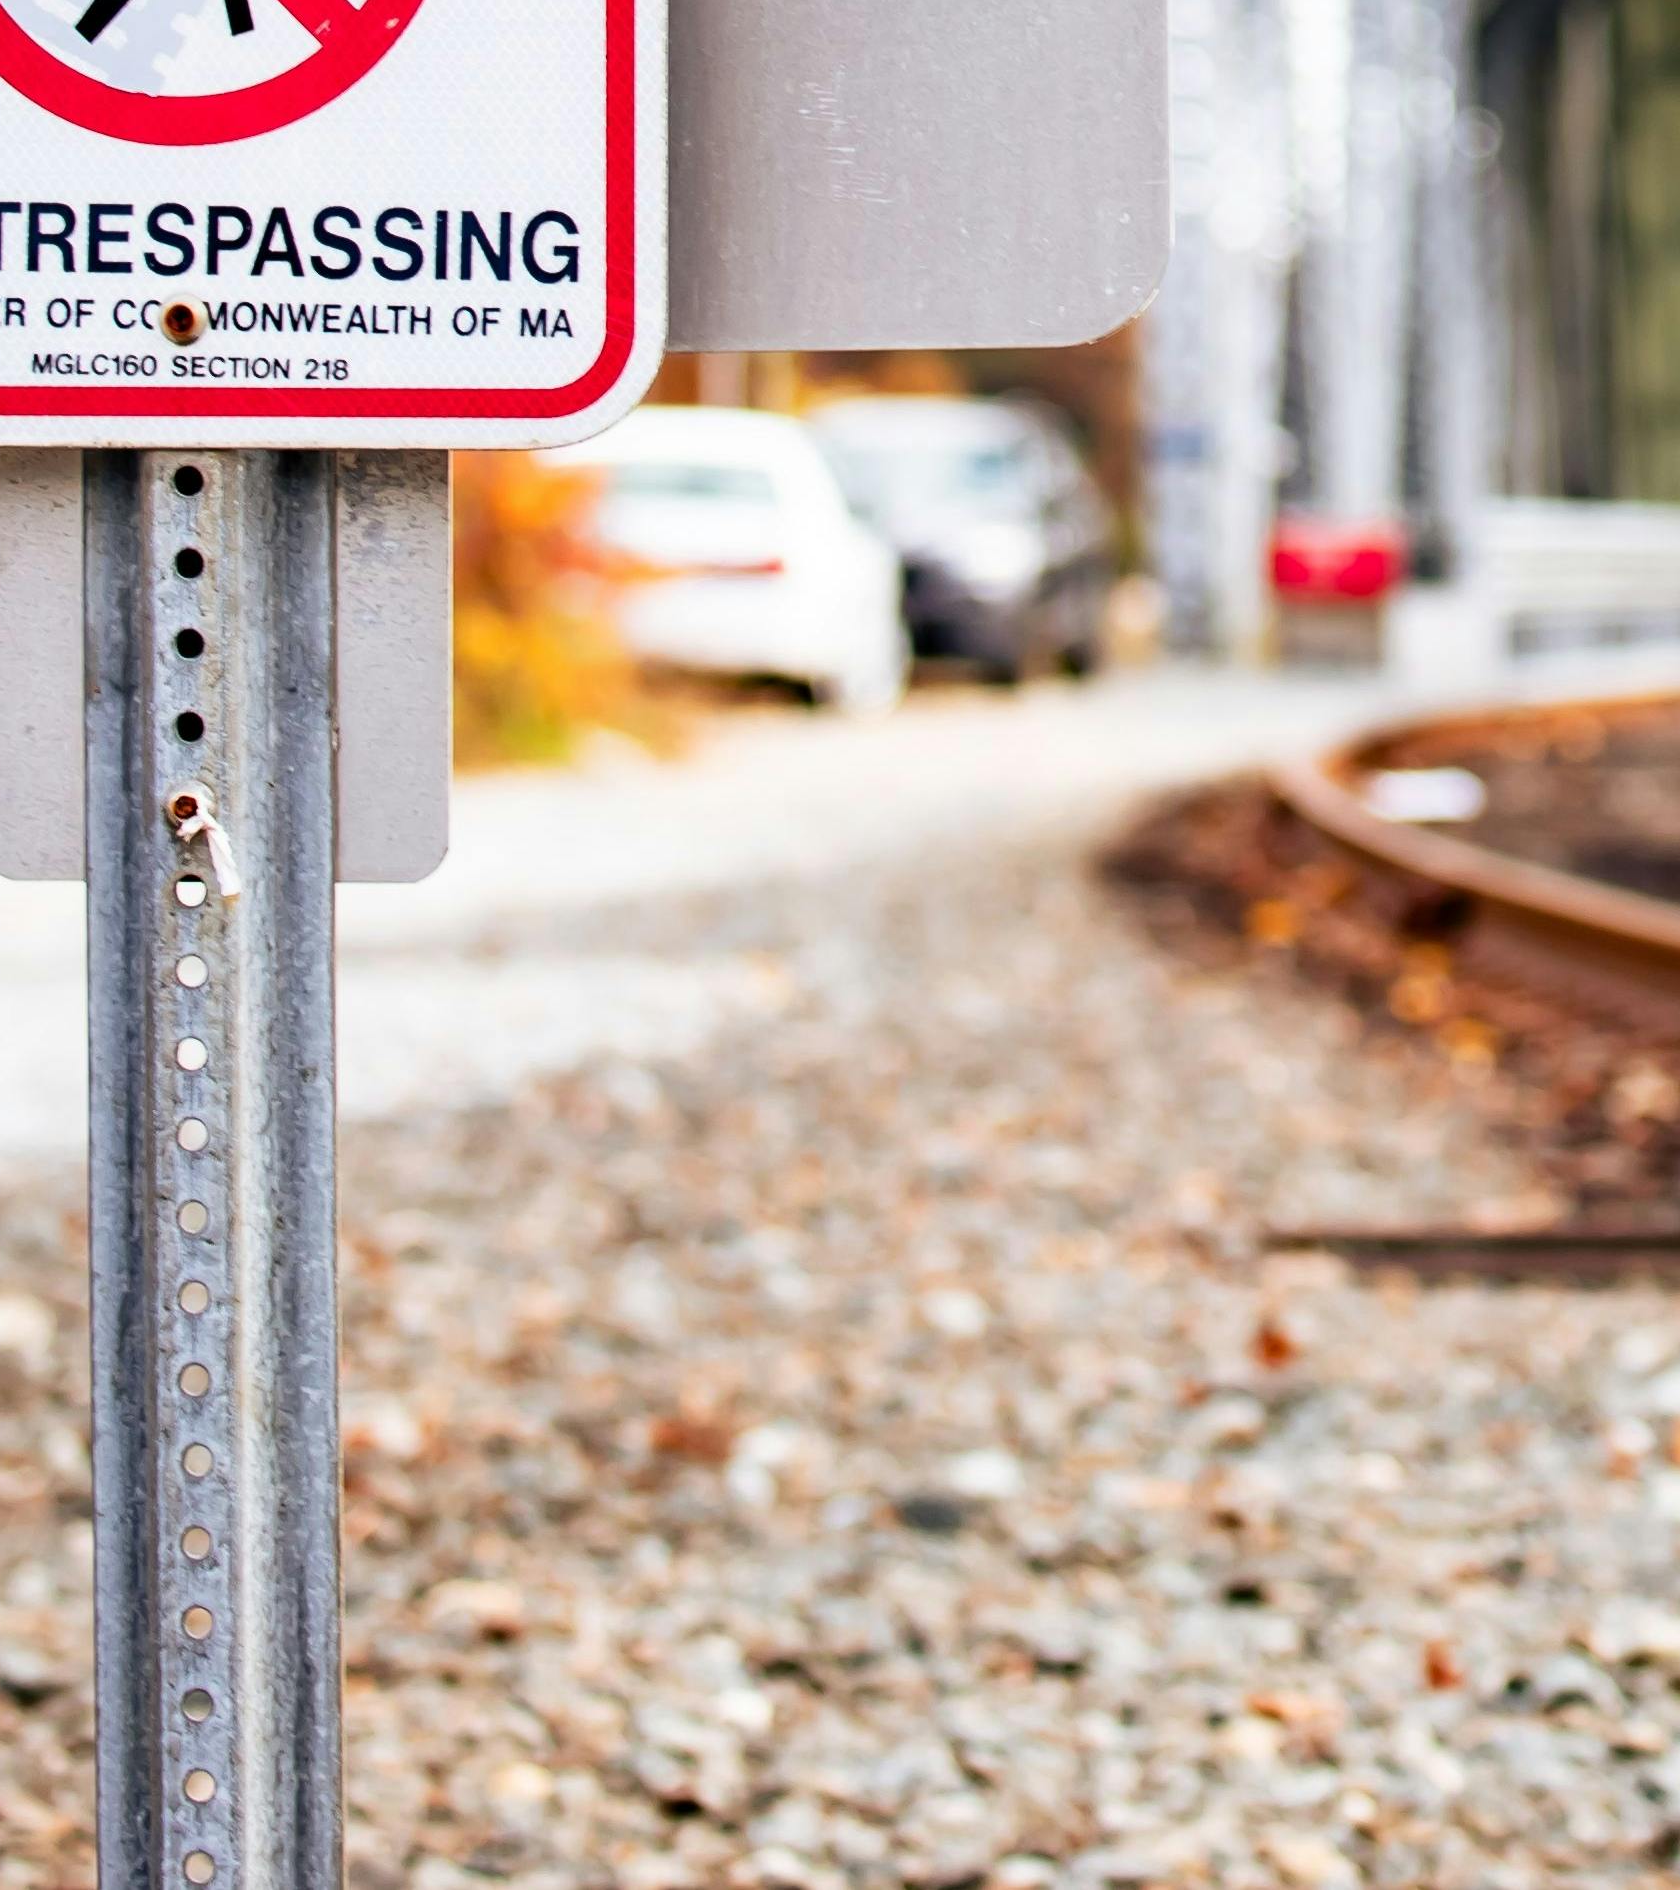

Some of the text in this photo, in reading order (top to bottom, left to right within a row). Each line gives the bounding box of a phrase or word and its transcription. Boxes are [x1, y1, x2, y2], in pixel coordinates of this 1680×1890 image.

[47, 298, 95, 328] OF
[113, 299, 432, 335] COMONWEALTH
[453, 306, 501, 337] OF
[521, 309, 573, 338] MA
[33, 353, 349, 381] MGLC160 SECTION 218
